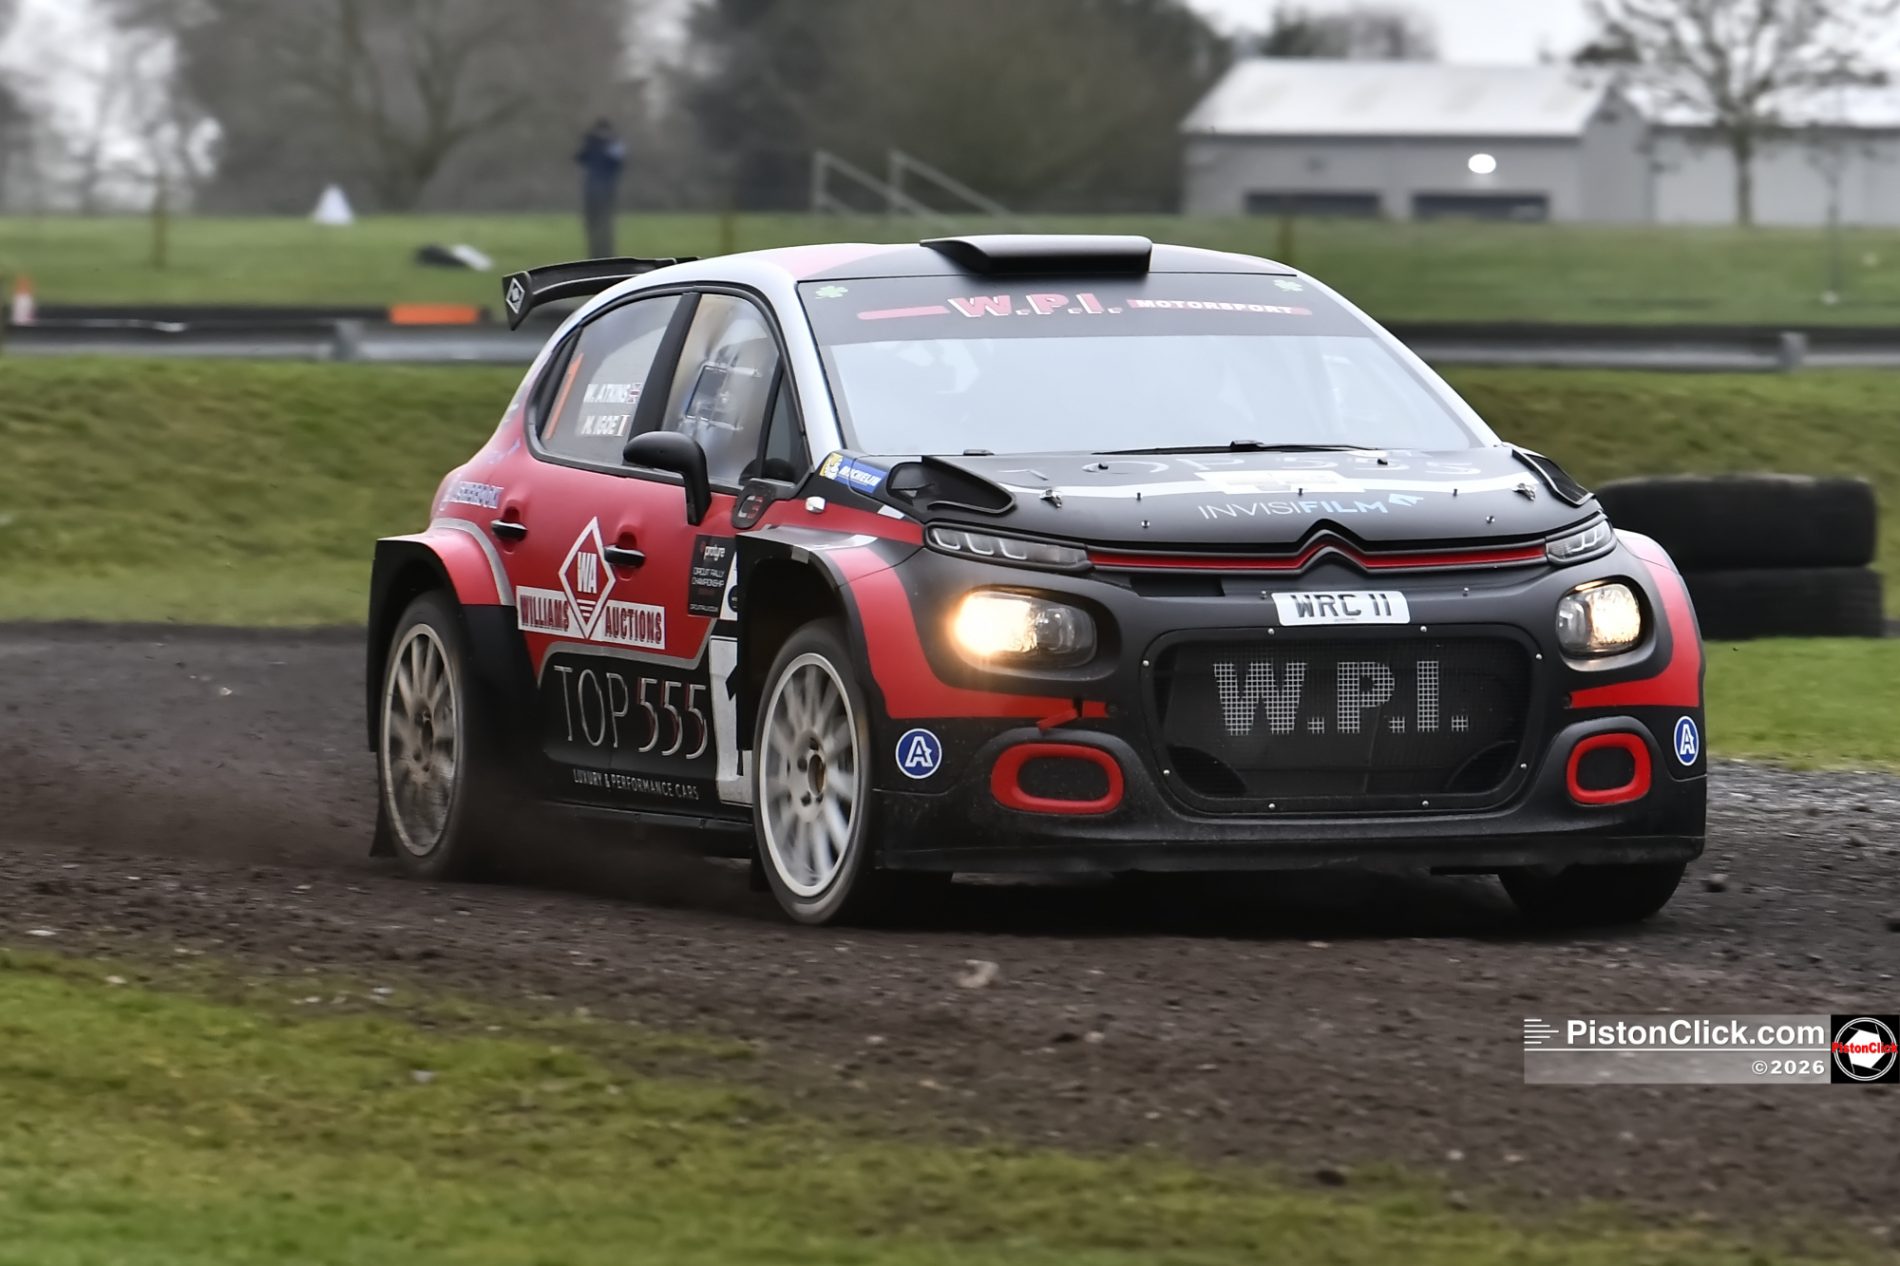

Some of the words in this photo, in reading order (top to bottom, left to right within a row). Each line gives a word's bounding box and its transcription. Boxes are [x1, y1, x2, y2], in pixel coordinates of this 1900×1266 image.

[947, 293, 1123, 317] W.P.I.
[1136, 299, 1293, 314] MOTORSPORT
[1198, 500, 1388, 520] INVISIFILM
[520, 594, 569, 632] WILLIAMS
[1290, 594, 1362, 618] WRC
[604, 606, 662, 644] AUCTIONS
[554, 666, 629, 749] TOP
[637, 677, 708, 760] 555
[1213, 660, 1469, 736] W.P.I.
[675, 783, 699, 801] CARS
